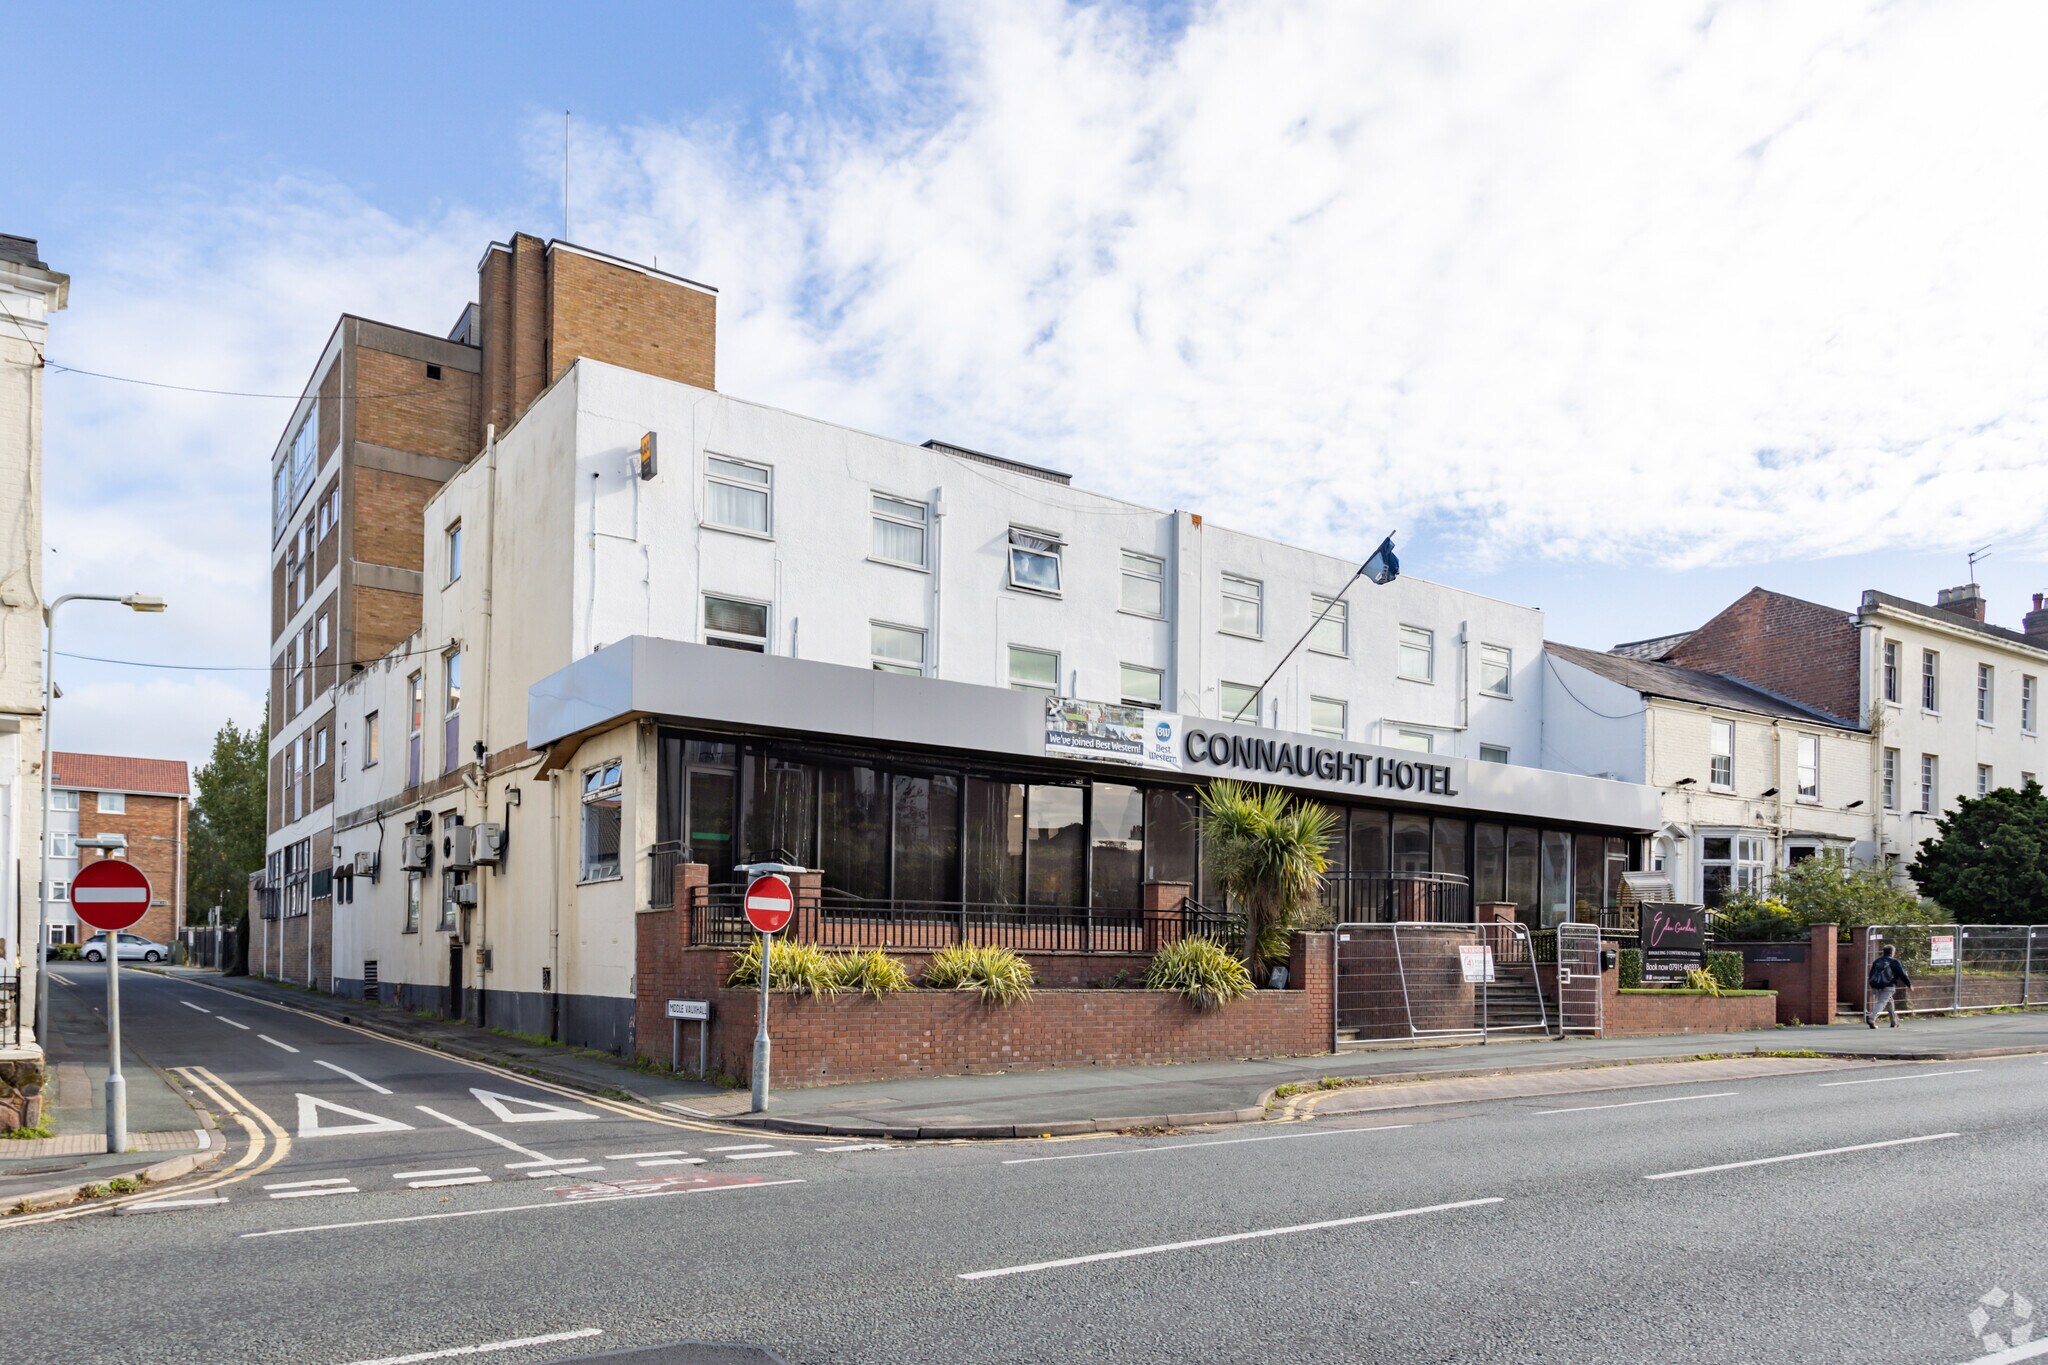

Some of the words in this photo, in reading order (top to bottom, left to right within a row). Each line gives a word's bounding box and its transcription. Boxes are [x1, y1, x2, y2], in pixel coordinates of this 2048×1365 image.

[1157, 726, 1170, 738] BW
[1049, 733, 1071, 745] We've
[1071, 736, 1094, 747] joined
[1096, 740, 1110, 749] Best
[1111, 742, 1141, 753] Western!
[1156, 744, 1171, 754] Best
[1148, 751, 1177, 763] Western
[1186, 728, 1373, 784] CONNAUGHT
[1378, 756, 1459, 796] HOTEL
[1651, 911, 1674, 947] Eden
[1646, 962, 1658, 971] Book
[1669, 963, 1683, 971] 07915
[670, 1004, 684, 1013] MIDDLE
